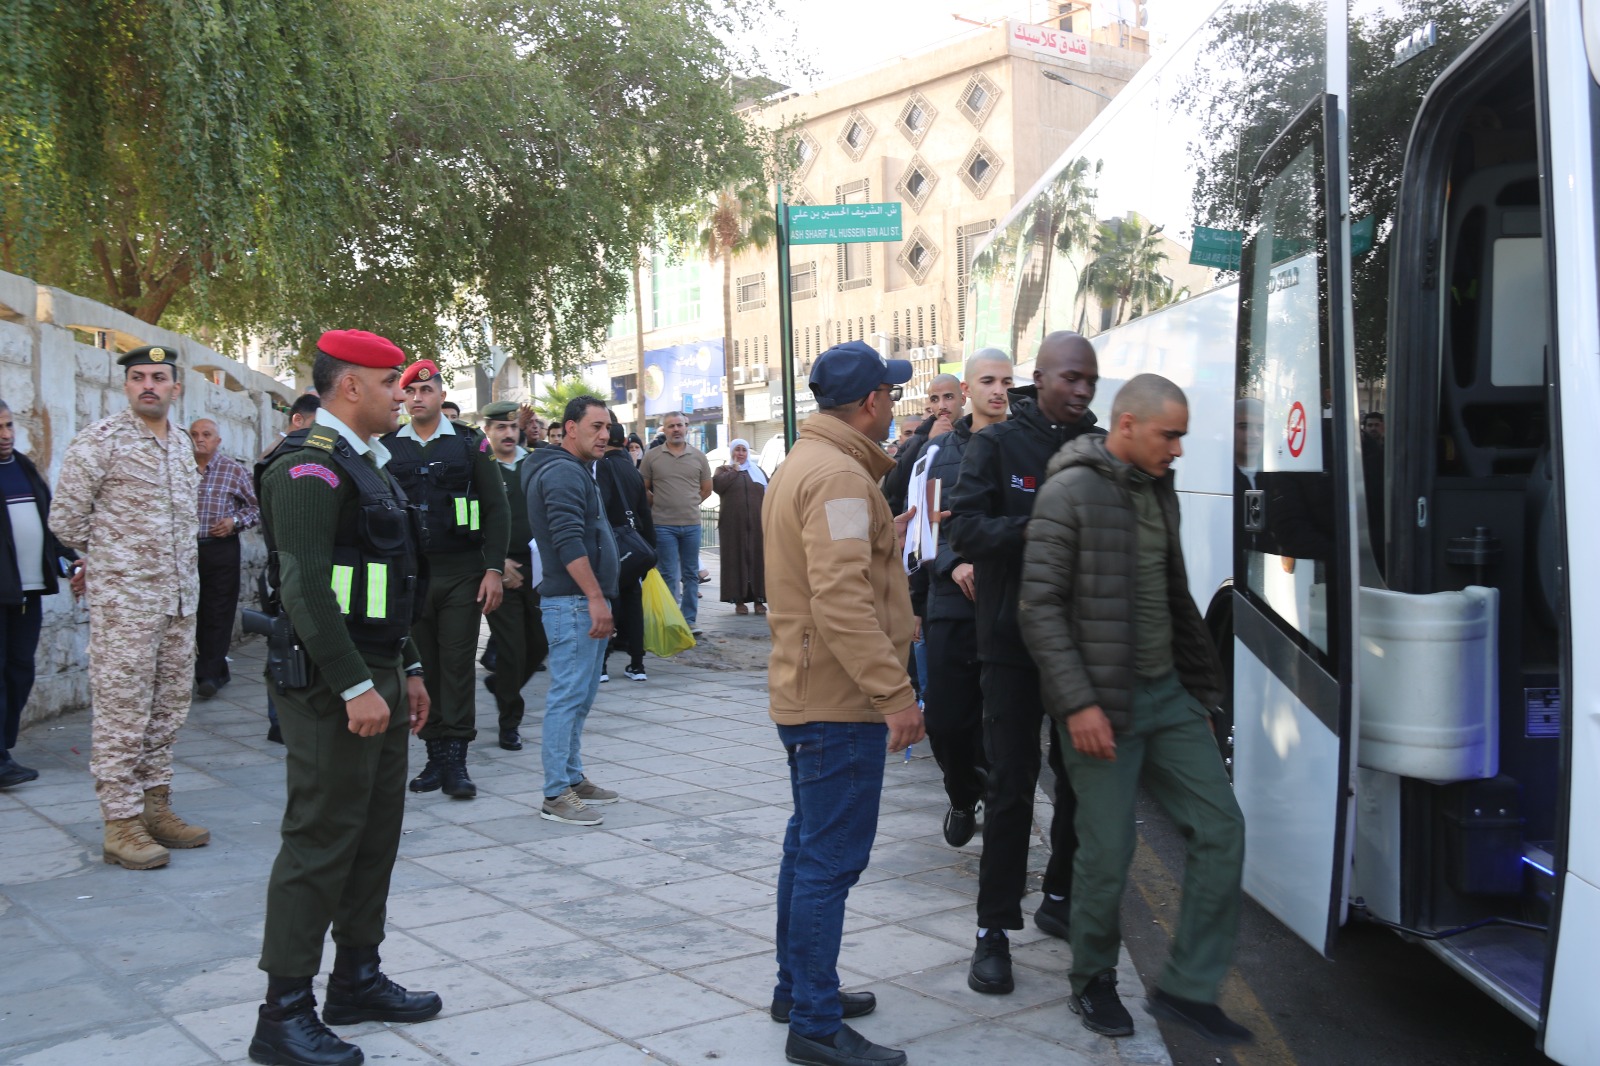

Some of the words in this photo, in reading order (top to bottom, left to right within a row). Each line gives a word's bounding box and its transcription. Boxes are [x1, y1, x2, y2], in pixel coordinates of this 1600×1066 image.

[1014, 25, 1057, 48] كلاسيك
[1058, 35, 1087, 56] فندق
[792, 209, 808, 224] علي
[810, 210, 820, 220] بن
[821, 206, 849, 219] الحسين
[851, 204, 883, 218] الشريف
[791, 230, 804, 240] ASH
[805, 228, 828, 239] SHARIF
[829, 228, 838, 238] AL
[838, 227, 866, 238] HUSSEIN
[867, 227, 877, 237] BIN
[878, 226, 890, 236] ALI
[890, 226, 900, 236] ST.
